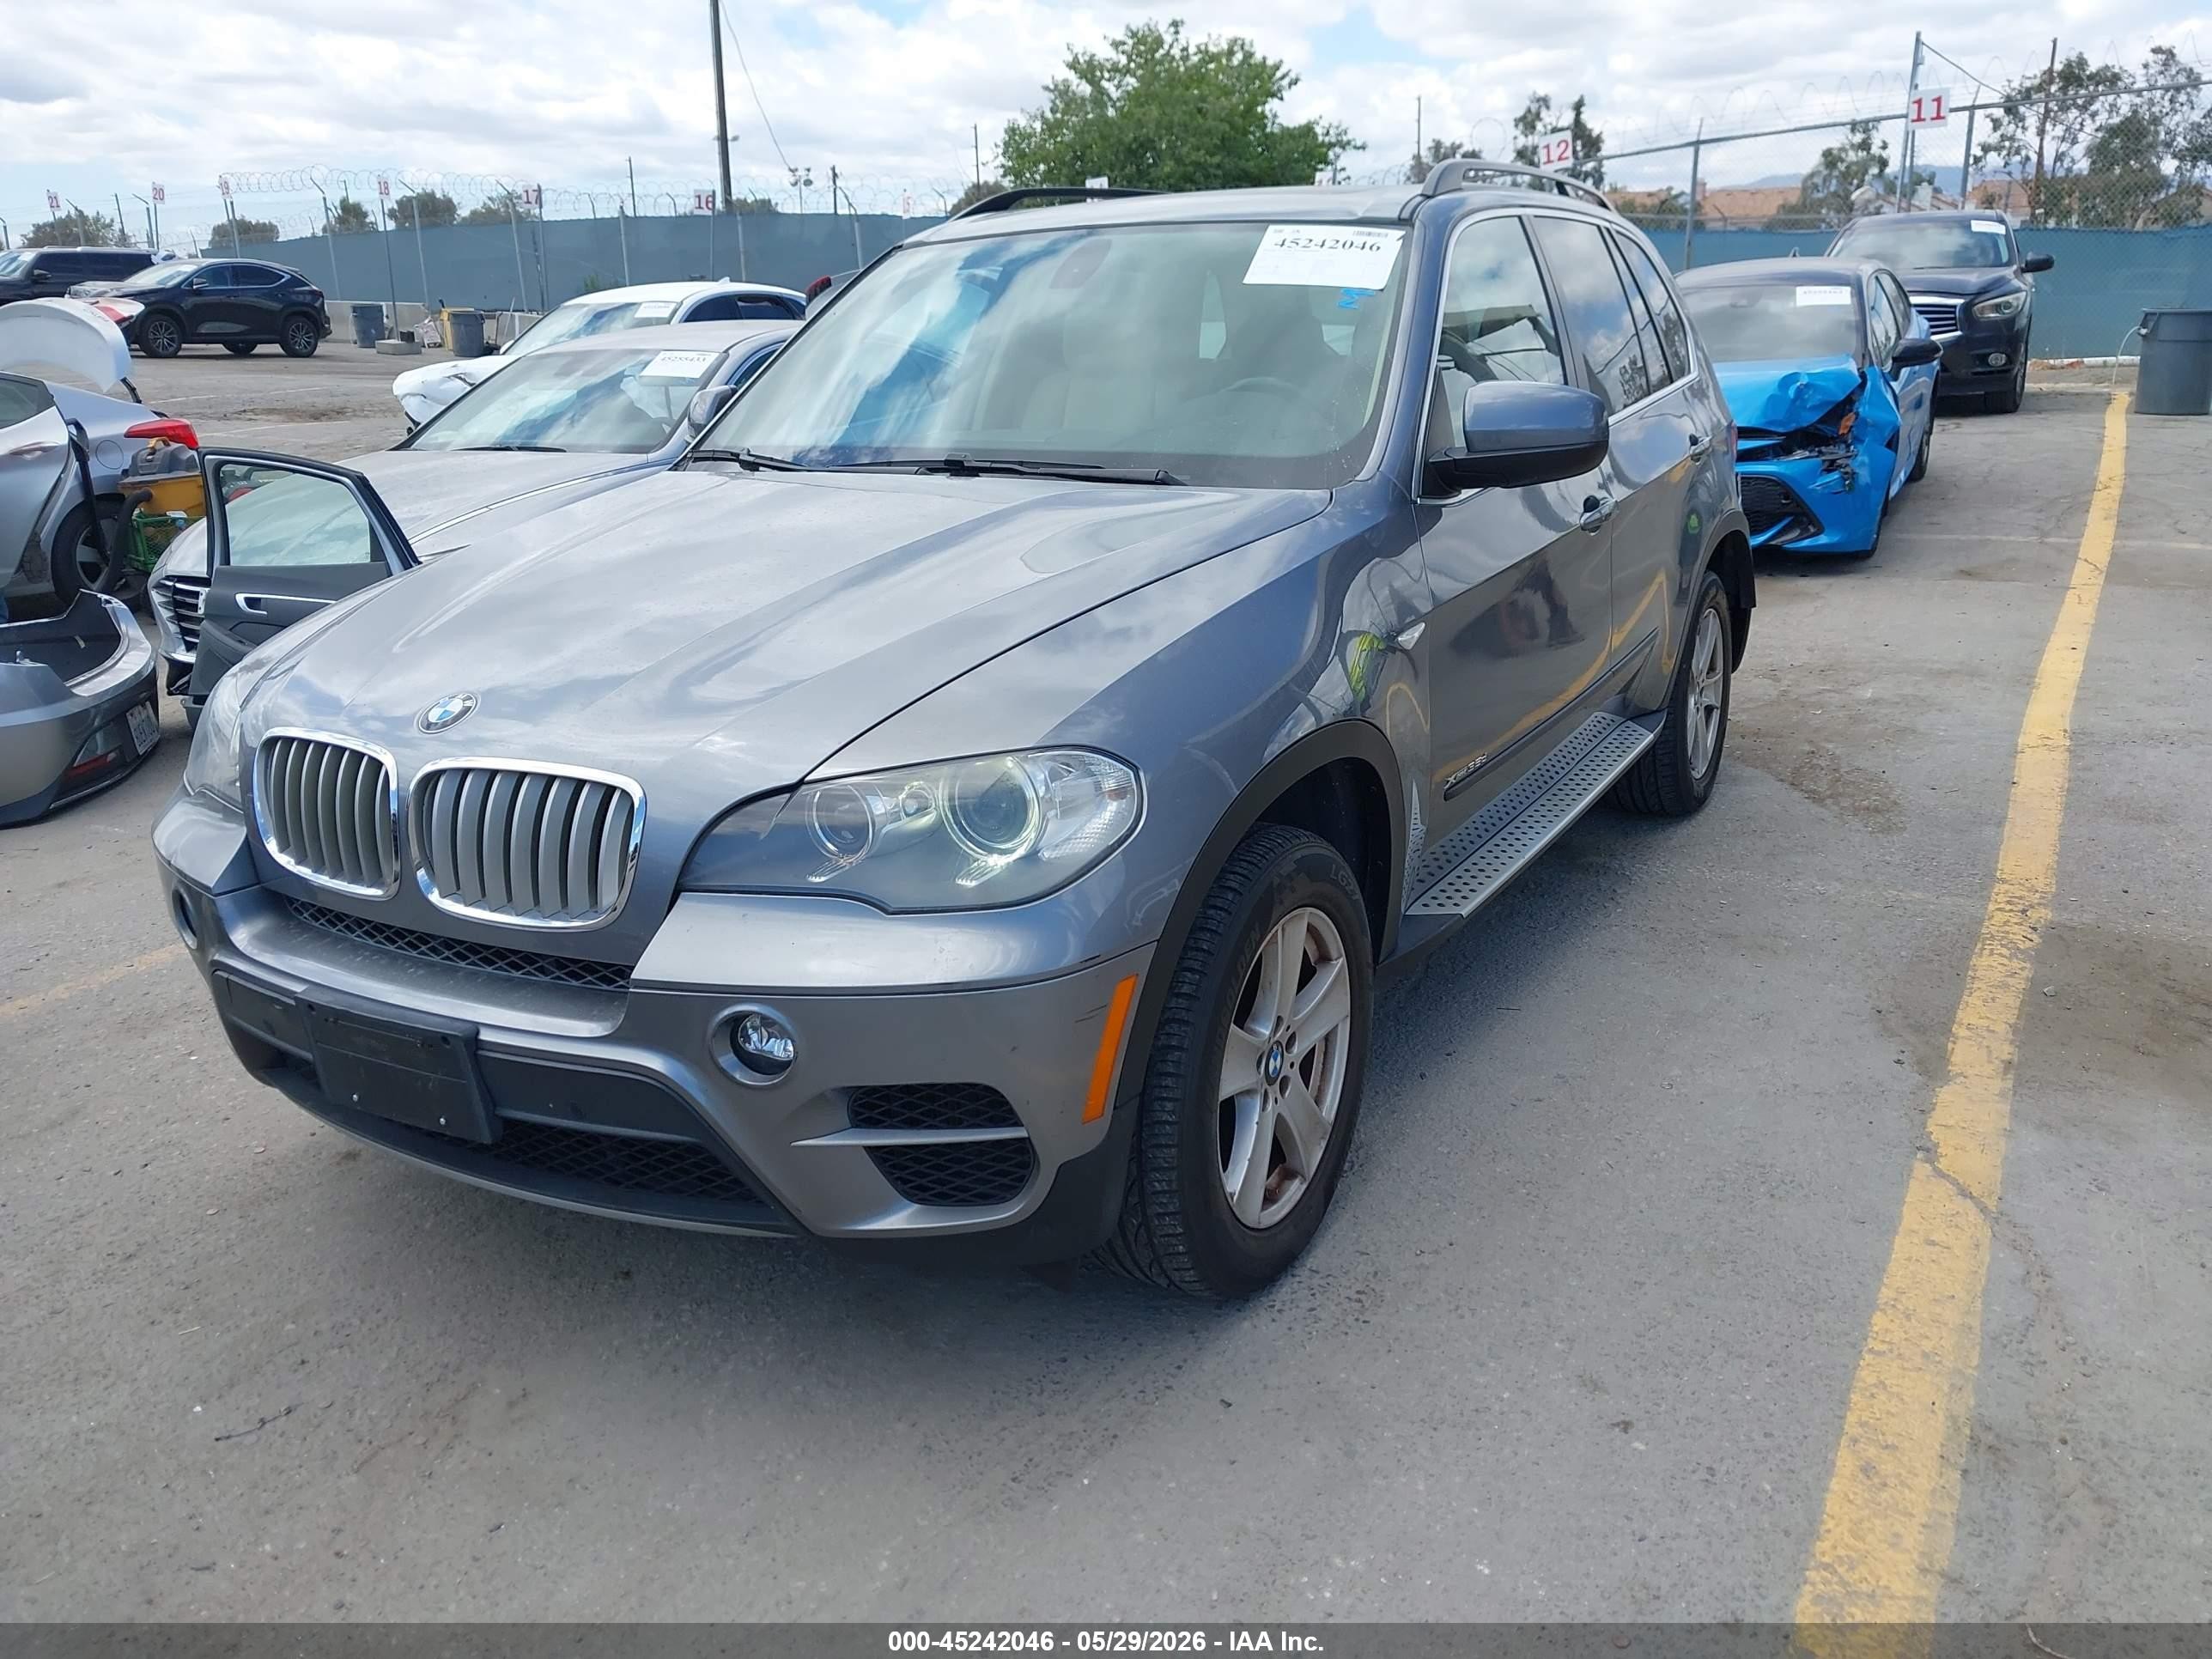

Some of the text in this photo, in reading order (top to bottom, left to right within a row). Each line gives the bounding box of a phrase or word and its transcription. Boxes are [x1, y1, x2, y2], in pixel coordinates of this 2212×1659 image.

[1911, 95, 1946, 123] 11
[1541, 139, 1570, 165] 12
[152, 187, 165, 201] 20
[219, 180, 230, 196] 19
[378, 179, 390, 196] 18
[47, 195, 61, 209] 21
[522, 188, 540, 205] 17
[694, 194, 714, 210] 16
[1273, 237, 1382, 252] 45242046
